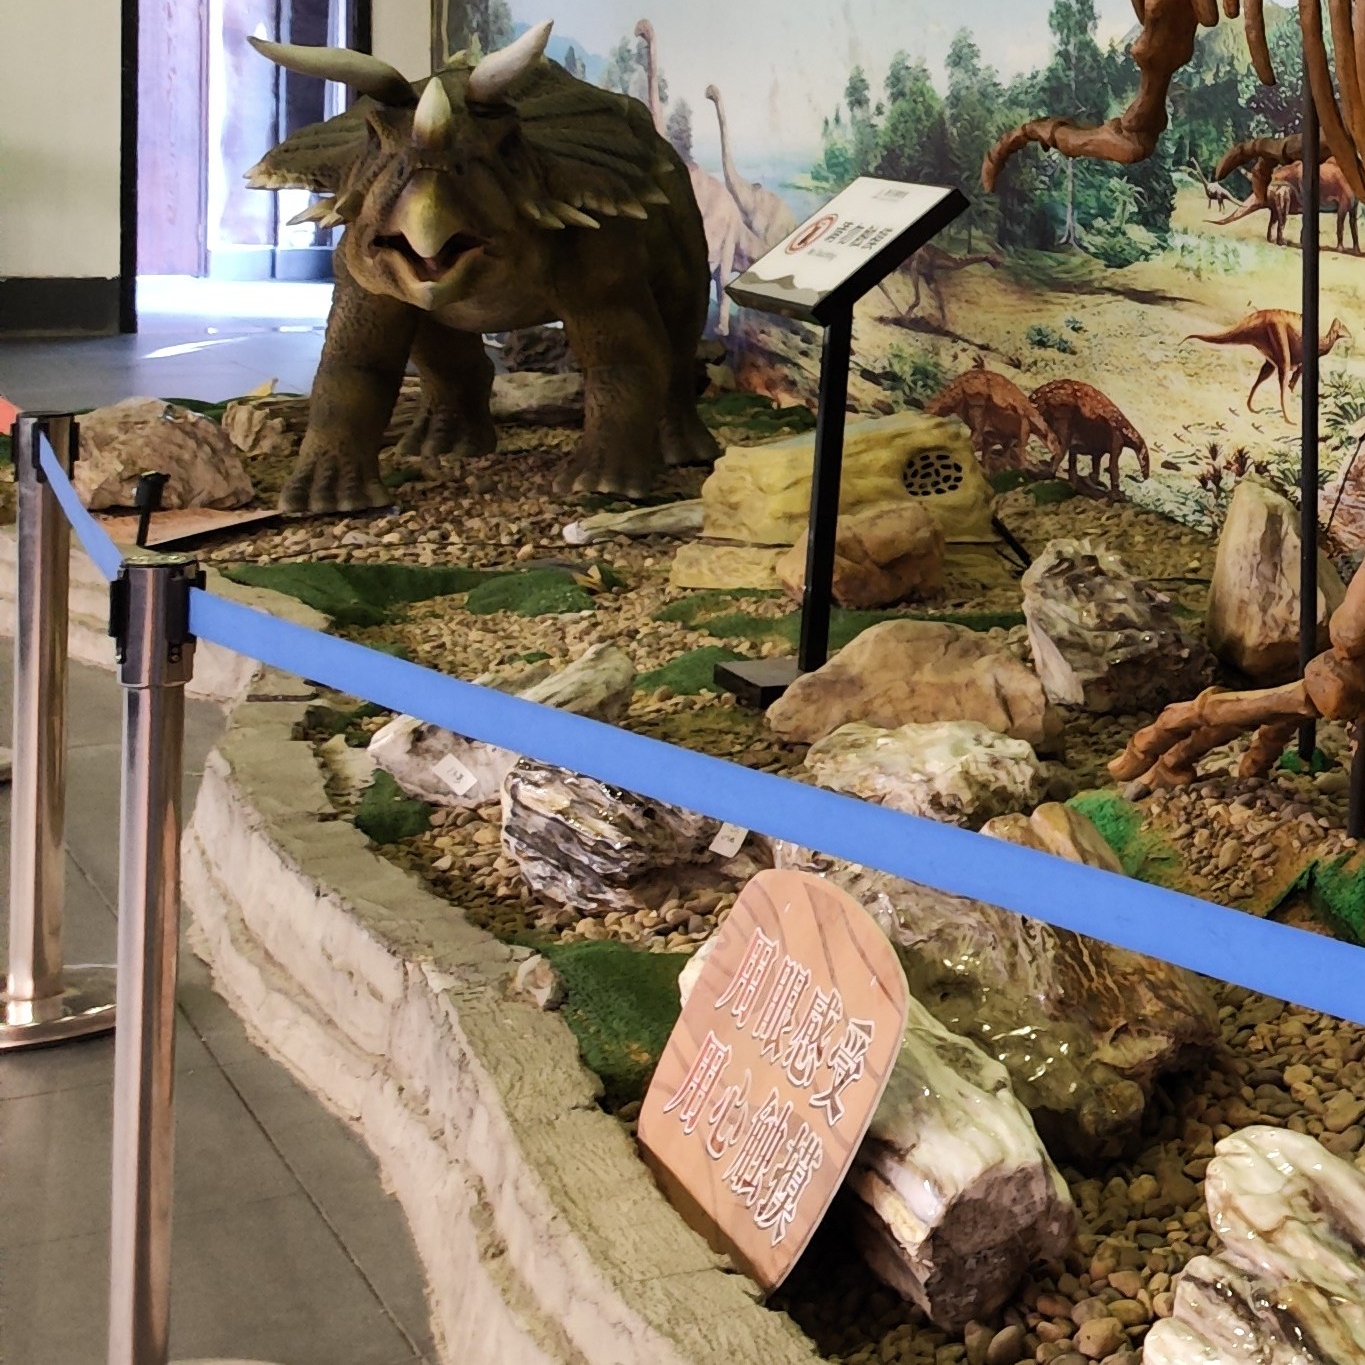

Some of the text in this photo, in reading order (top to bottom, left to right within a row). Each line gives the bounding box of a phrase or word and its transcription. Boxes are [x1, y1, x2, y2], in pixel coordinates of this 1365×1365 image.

[713, 926, 877, 1126] 用眼感受
[663, 1030, 825, 1247] 用心触摸
